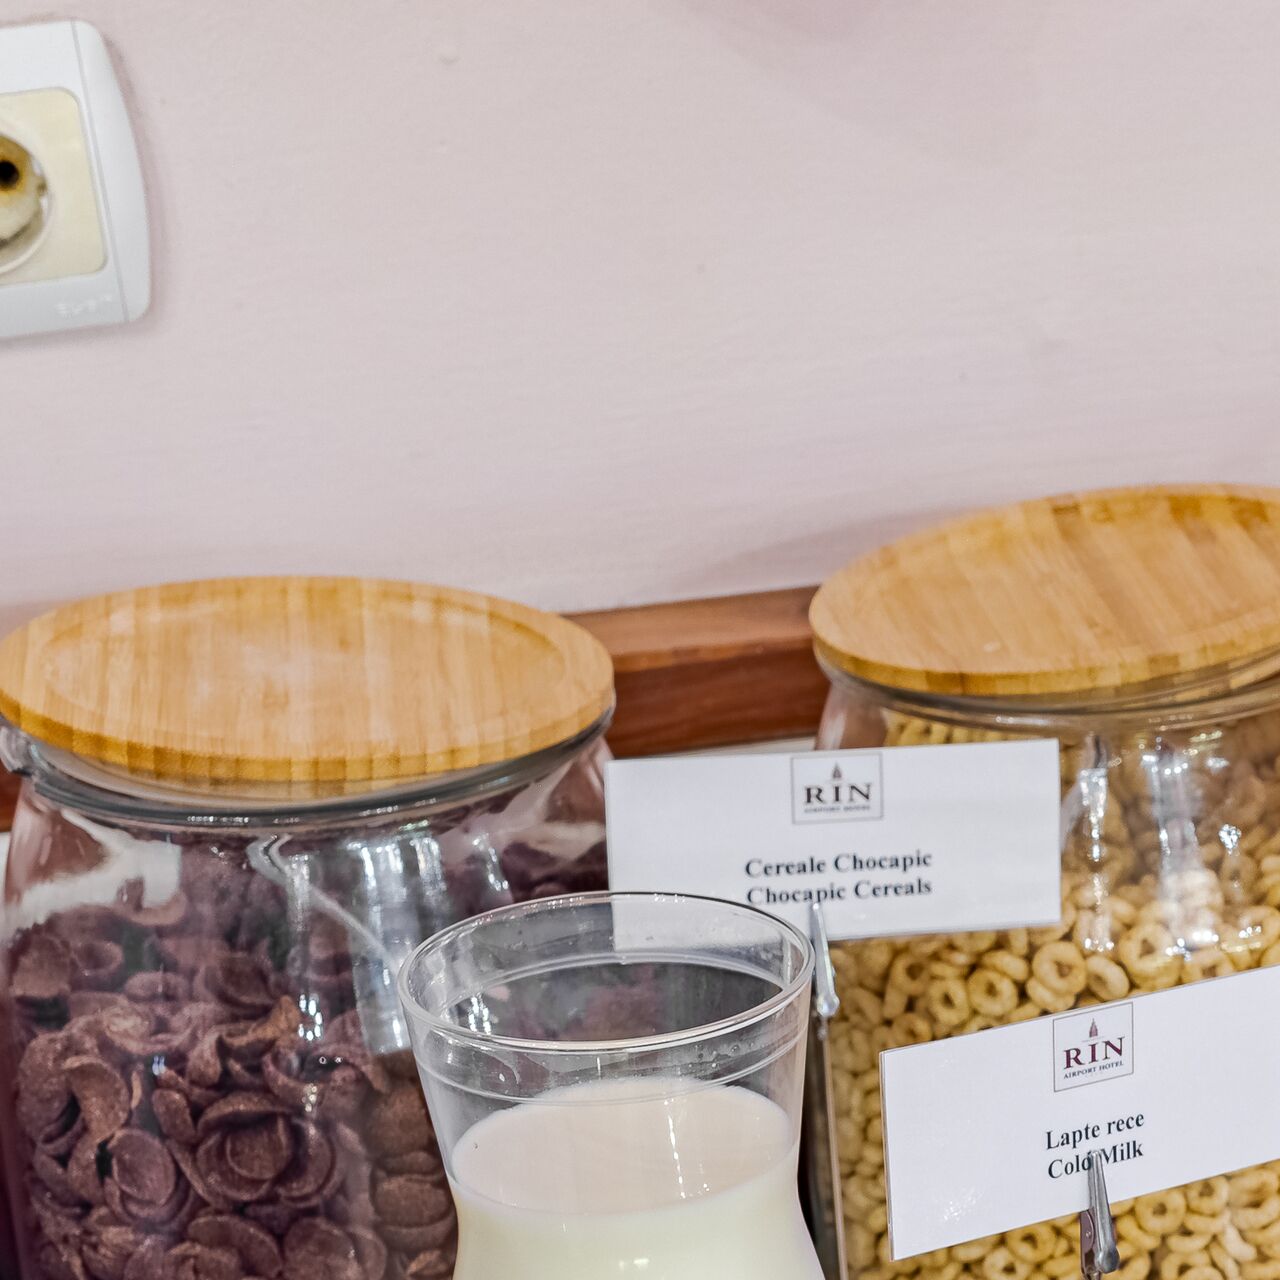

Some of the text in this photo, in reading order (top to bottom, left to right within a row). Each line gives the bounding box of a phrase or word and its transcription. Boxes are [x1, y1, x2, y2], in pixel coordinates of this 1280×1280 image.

[804, 782, 873, 803] RIN
[745, 849, 933, 877] Cereale Chocapic
[746, 878, 932, 904] Chocapic Cereals
[1063, 1037, 1124, 1070] RIN
[1064, 1060, 1124, 1080] AIRPORT HOTEL
[1045, 1112, 1144, 1151] Lapte rece
[1100, 1141, 1143, 1164] Milk
